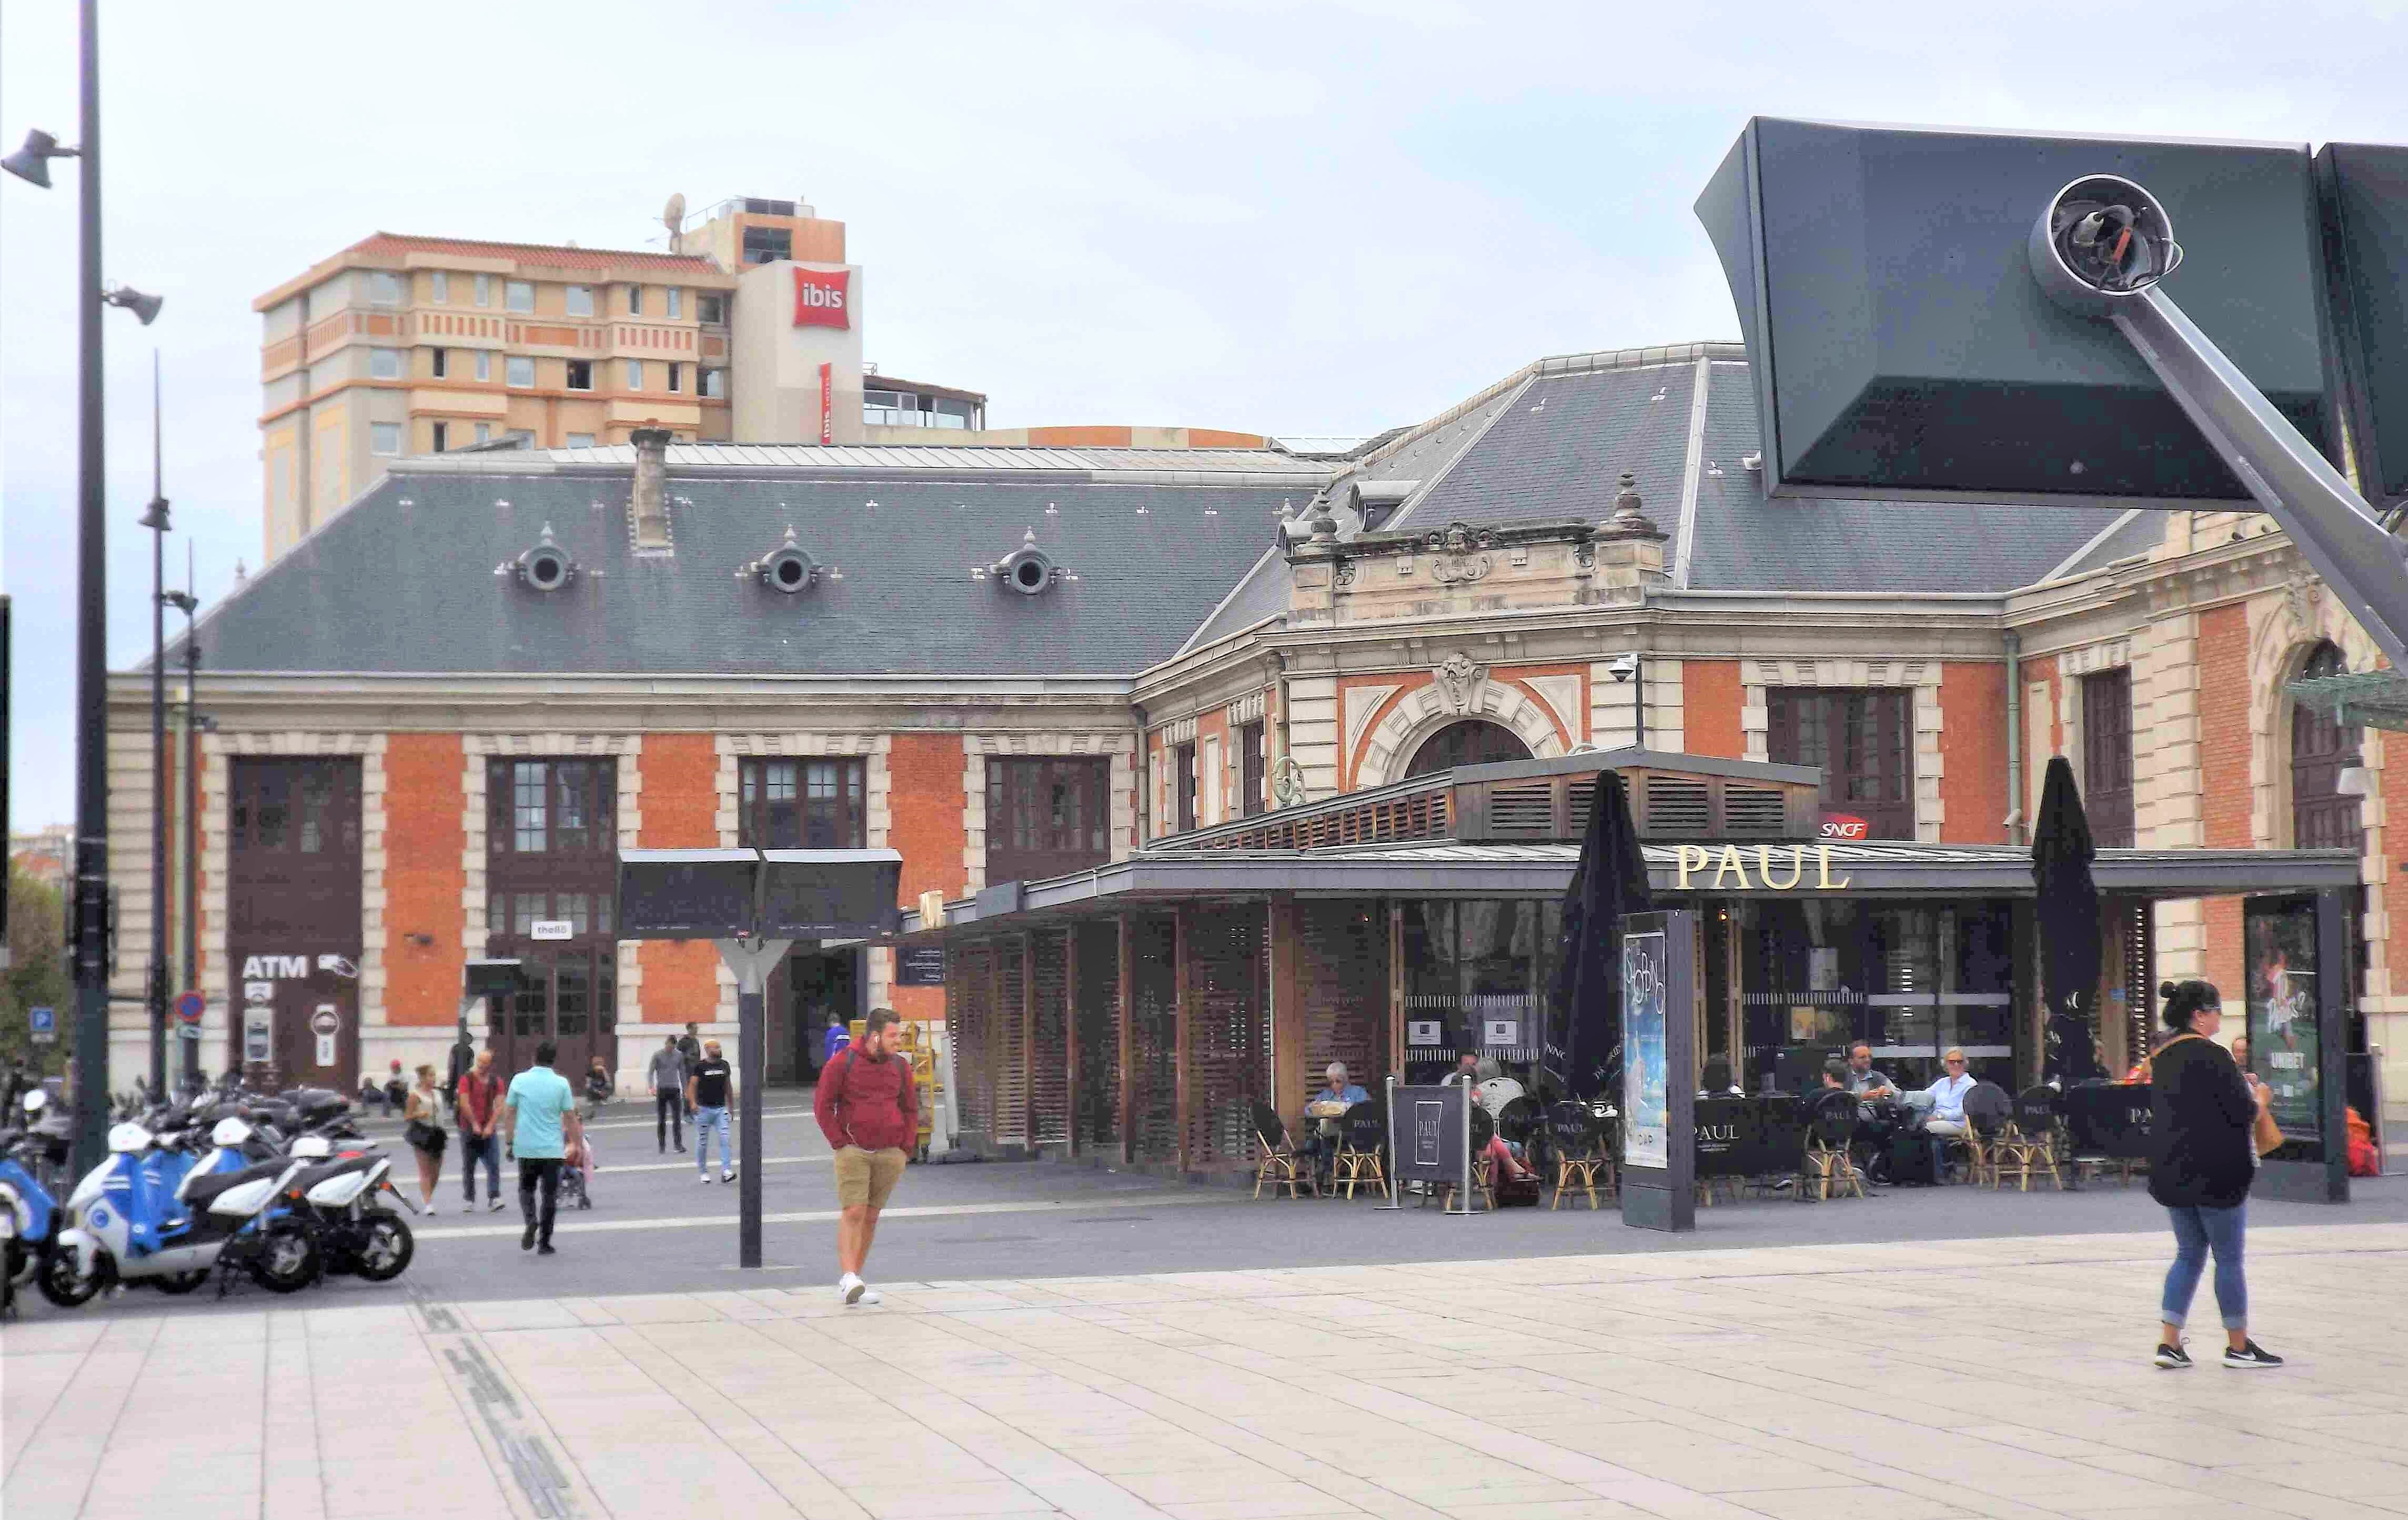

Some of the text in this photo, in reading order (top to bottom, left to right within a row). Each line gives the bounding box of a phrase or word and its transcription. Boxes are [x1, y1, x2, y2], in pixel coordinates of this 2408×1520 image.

[803, 283, 842, 308] ibis
[1820, 823, 1865, 837] SNCF
[1672, 844, 1851, 890] PAUL
[243, 955, 309, 978] ATM
